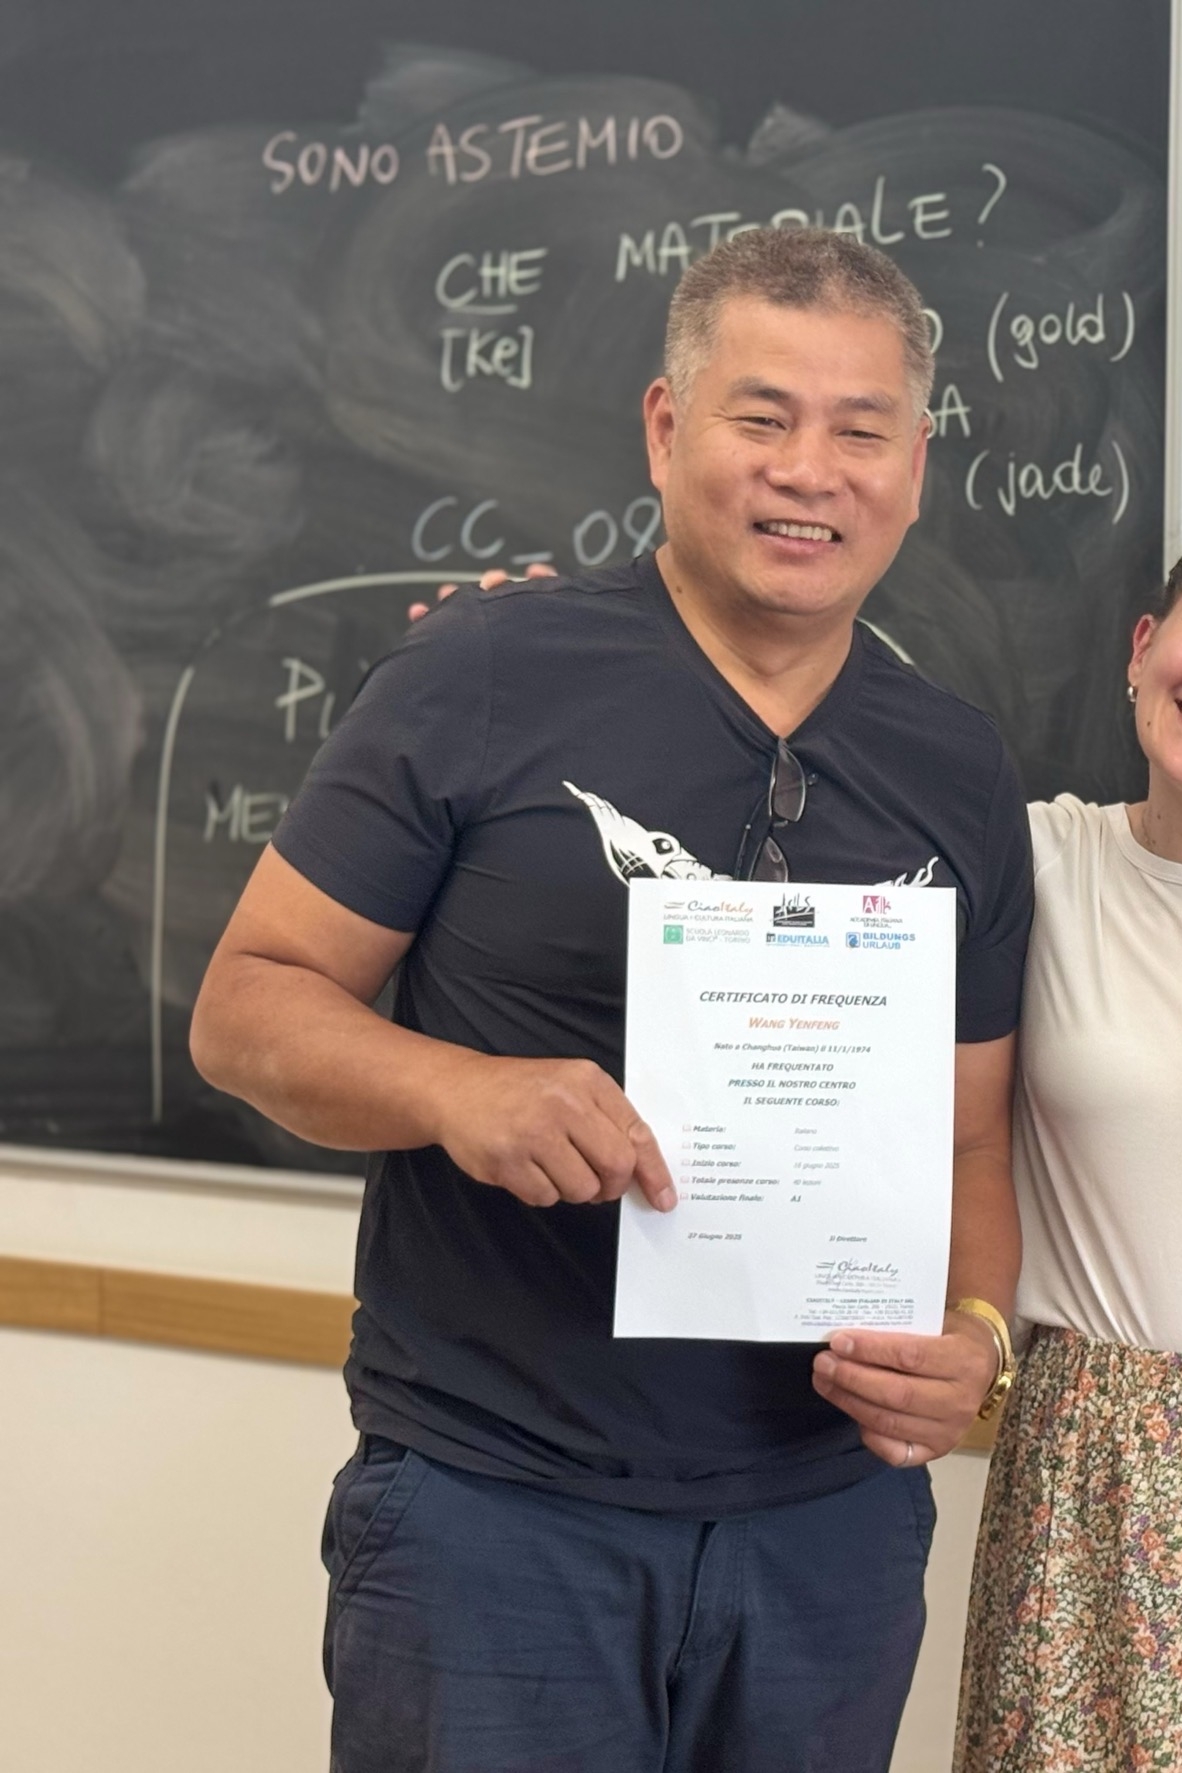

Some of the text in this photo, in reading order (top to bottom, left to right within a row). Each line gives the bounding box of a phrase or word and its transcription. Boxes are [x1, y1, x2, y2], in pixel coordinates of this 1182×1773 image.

[263, 115, 684, 194] SONO ASTEMIO
[436, 248, 549, 312] CHE
[988, 291, 1135, 383] (gold)
[966, 442, 1130, 525] (jade)
[776, 934, 828, 944] EDUITALIA
[862, 932, 915, 941] BILDUNGS
[862, 940, 901, 949] URLAUB
[699, 990, 886, 1007] CERTIFICATO DI FREQUENZA
[713, 1042, 733, 1050] Nato
[782, 1043, 819, 1053] (Taiwan)
[751, 1062, 834, 1072] HA FREQUENTATO
[727, 1078, 856, 1089] PRESSO IL NOSTRO CENTRO
[742, 1096, 839, 1106] IL SEGUENTE CORSO:
[693, 1141, 710, 1150] Tipo
[691, 1176, 716, 1184] Totale
